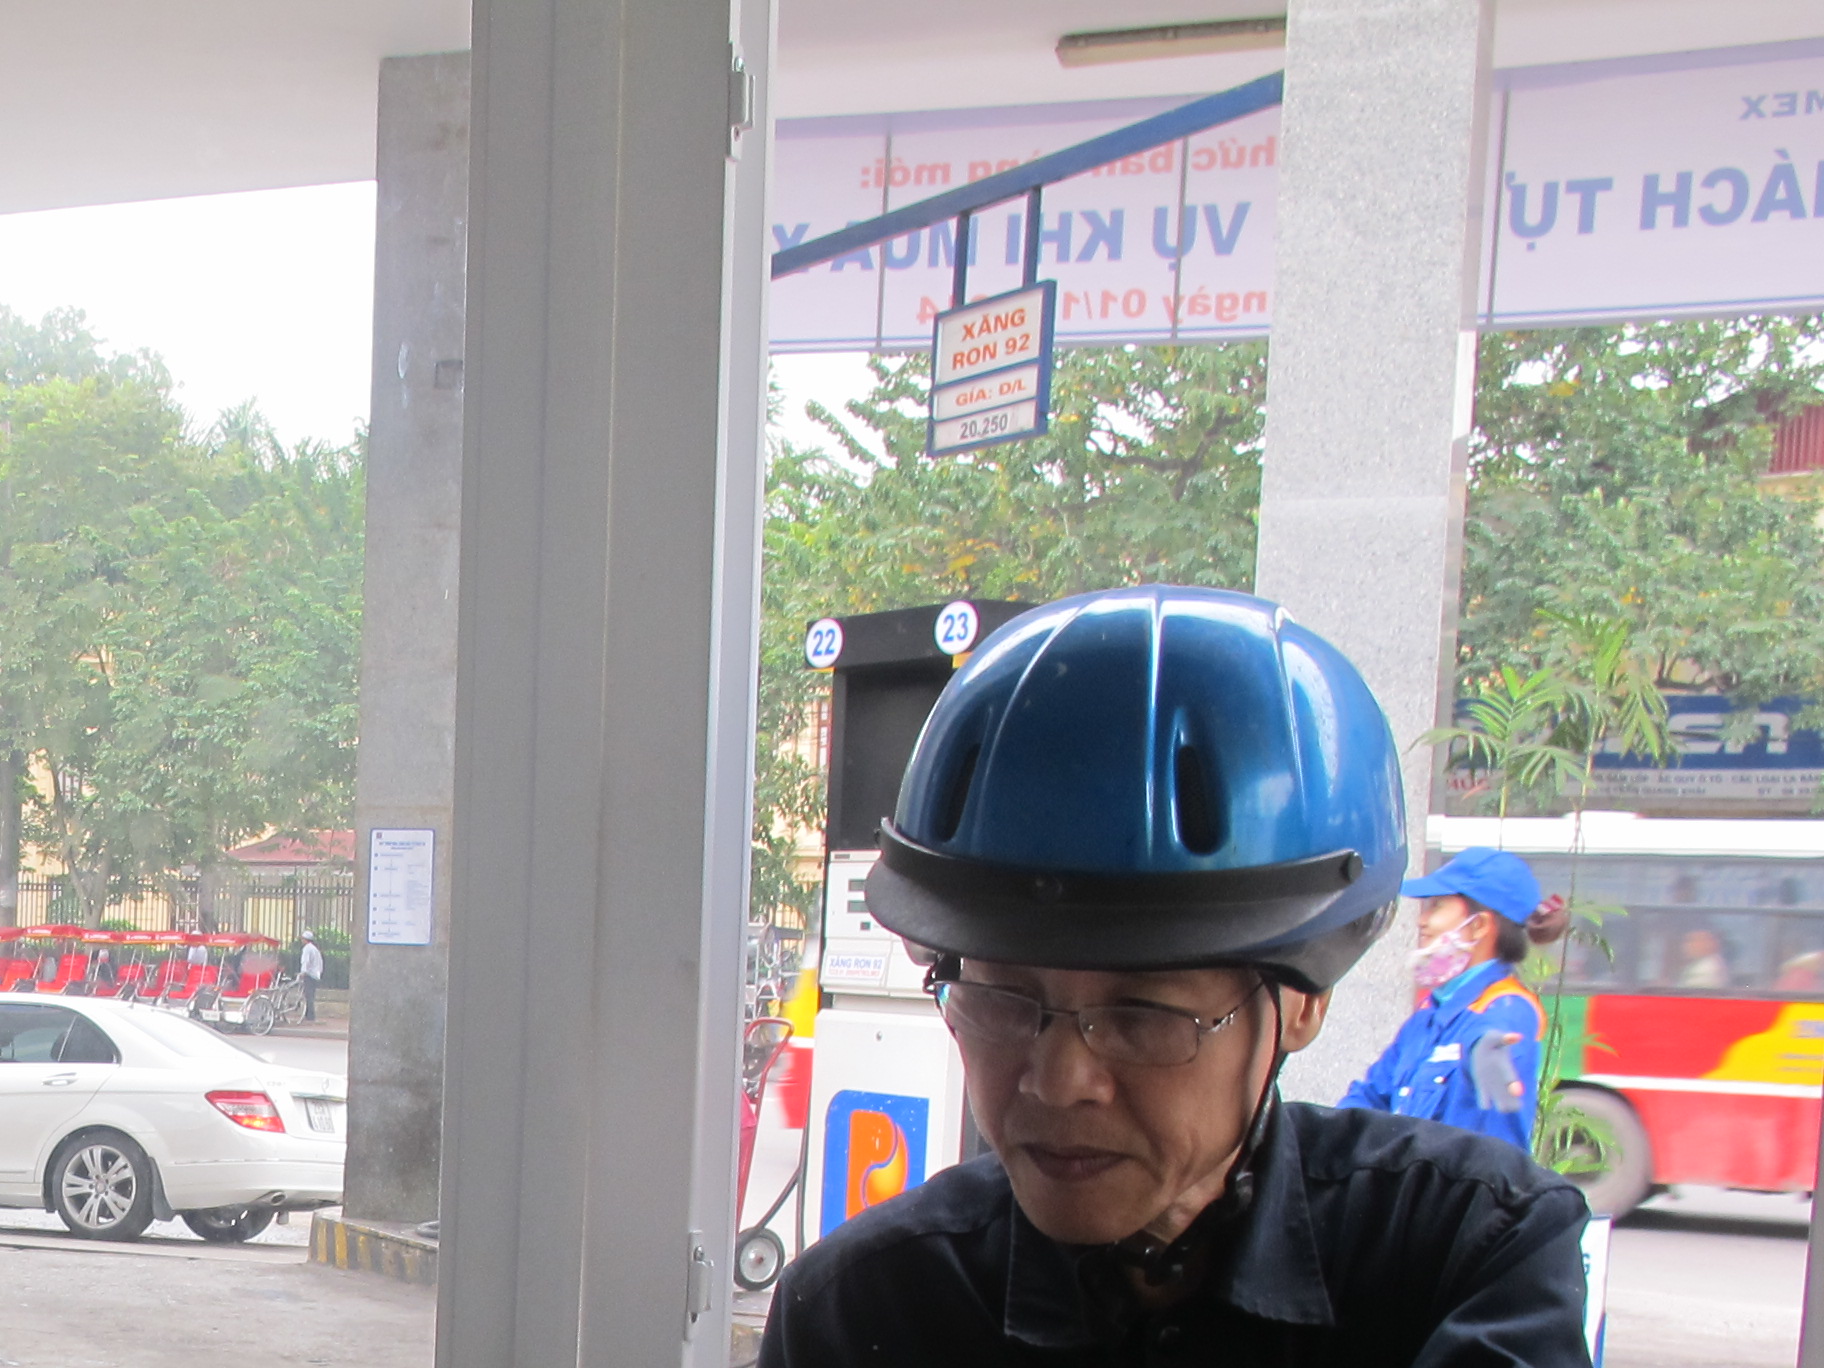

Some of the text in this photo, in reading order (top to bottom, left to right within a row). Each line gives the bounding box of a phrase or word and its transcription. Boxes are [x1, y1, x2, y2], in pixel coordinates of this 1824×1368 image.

[961, 307, 1026, 342] XĂNG
[952, 333, 1031, 371] RON 92
[959, 413, 1009, 441] 20.250
[812, 627, 836, 657] 22
[942, 611, 969, 643] 23
[854, 957, 870, 968] RON
